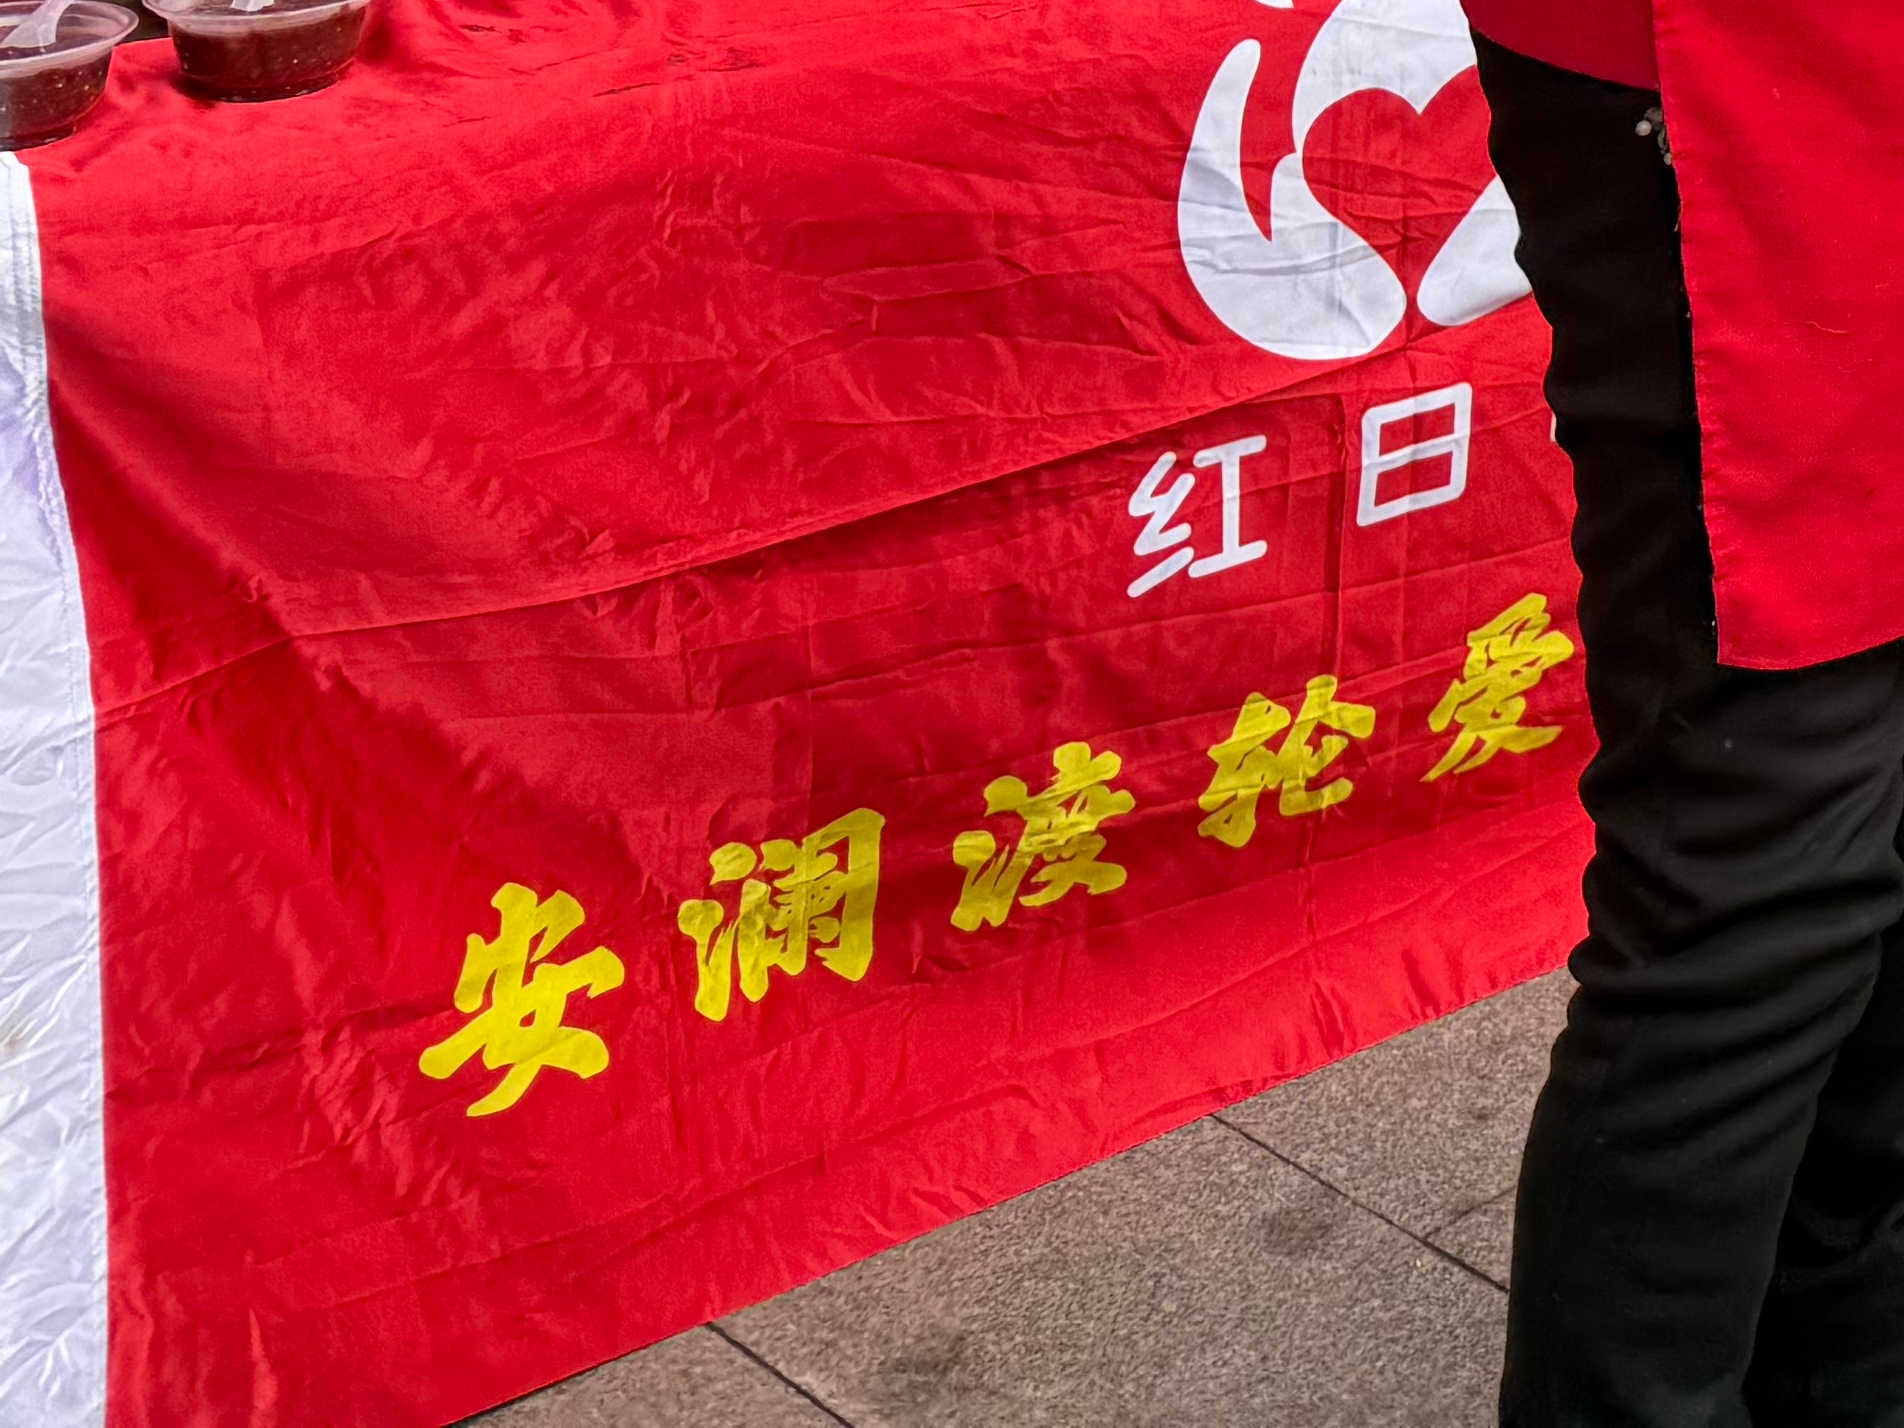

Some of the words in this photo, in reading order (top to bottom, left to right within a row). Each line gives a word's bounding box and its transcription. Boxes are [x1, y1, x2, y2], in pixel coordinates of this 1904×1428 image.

[1126, 382, 1475, 600] 红日
[418, 591, 1576, 1118] 安澜渡轮爱
